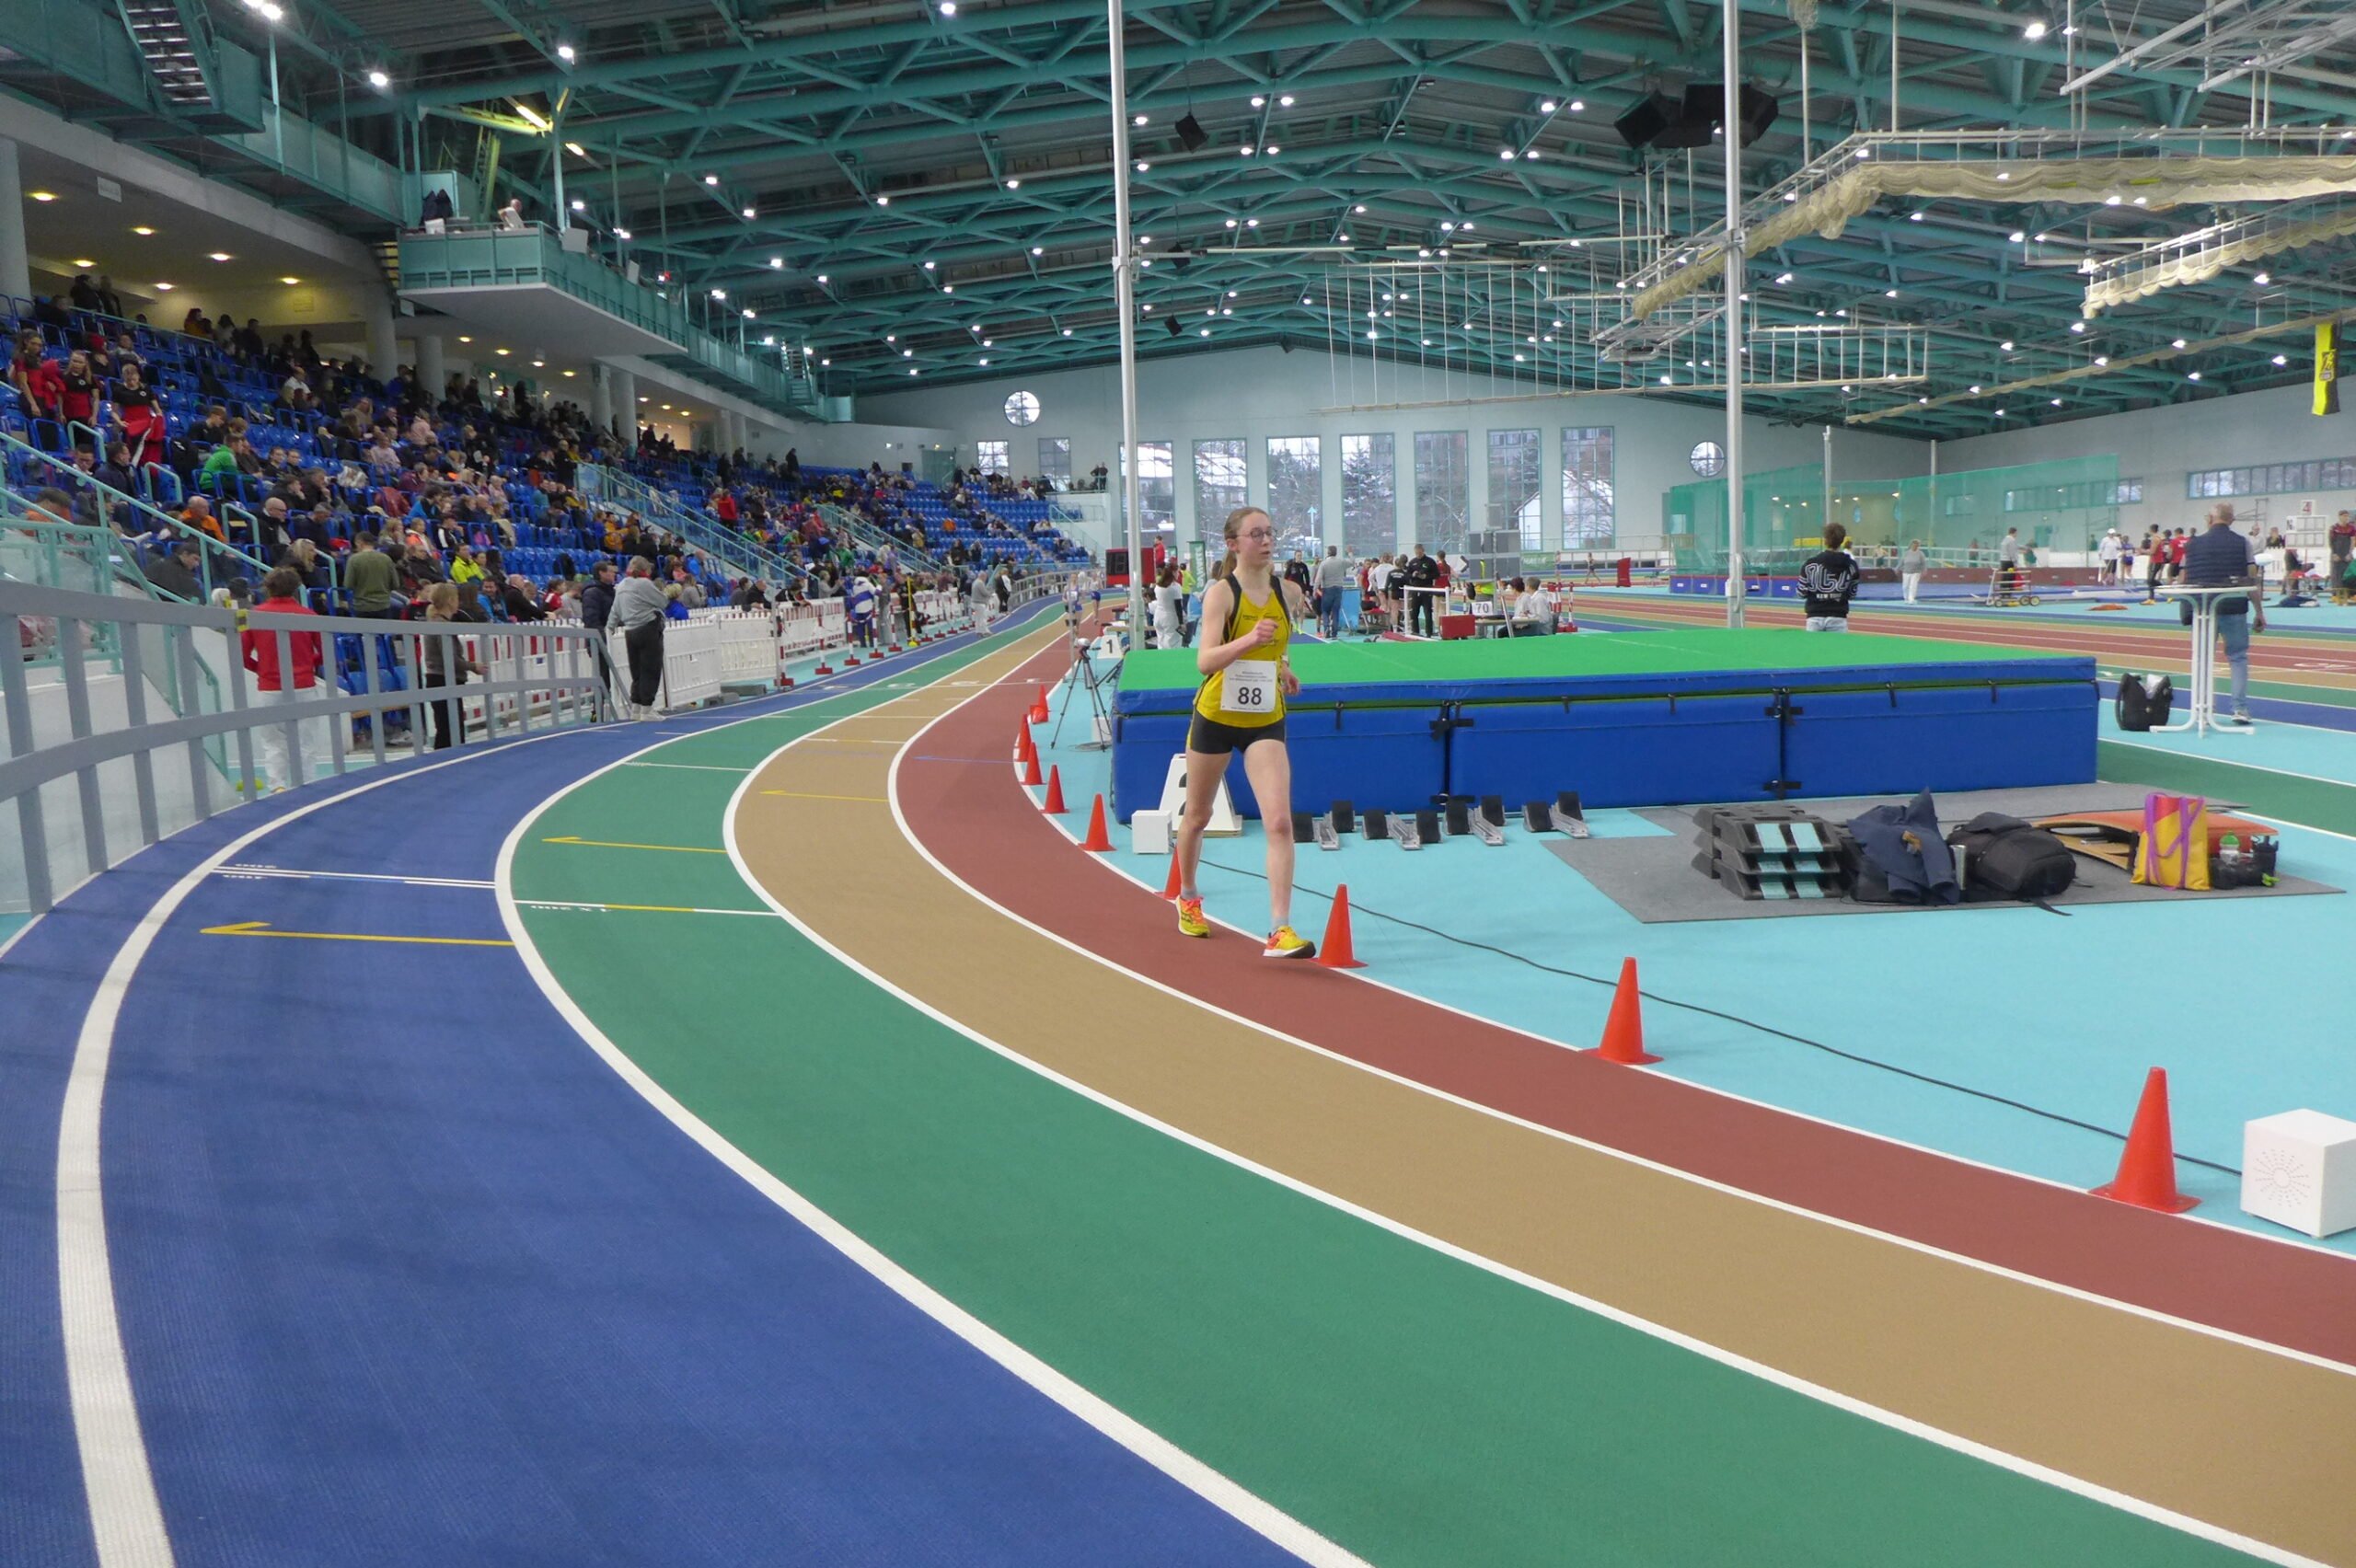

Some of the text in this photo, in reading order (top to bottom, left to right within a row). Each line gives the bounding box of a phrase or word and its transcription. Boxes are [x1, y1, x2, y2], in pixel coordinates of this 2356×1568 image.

[1475, 603, 1489, 614] 70
[1106, 640, 1114, 653] 1
[1237, 686, 1262, 706] 88
